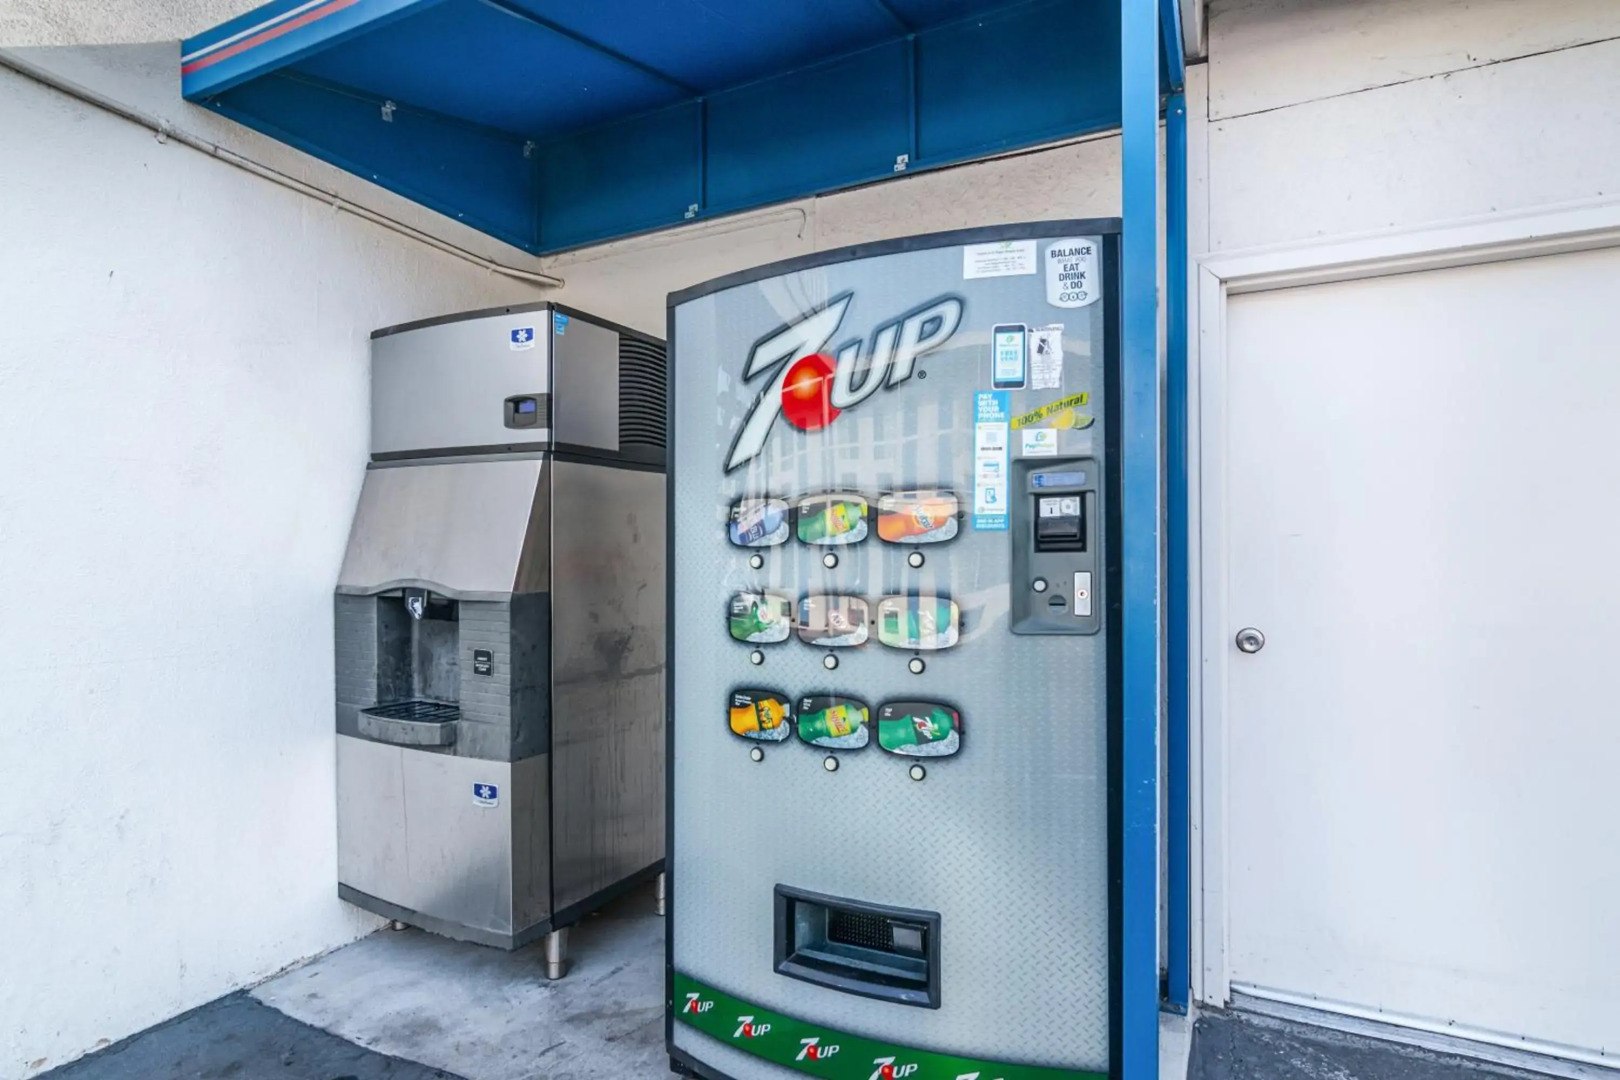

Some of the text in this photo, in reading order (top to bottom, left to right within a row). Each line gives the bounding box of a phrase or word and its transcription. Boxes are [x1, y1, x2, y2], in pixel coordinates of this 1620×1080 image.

[1050, 246, 1092, 258] BALANCE
[1063, 263, 1079, 272] EAT
[1058, 271, 1086, 281] DRINK
[1062, 280, 1082, 290] & DO
[1017, 393, 1084, 428] 100% Natural
